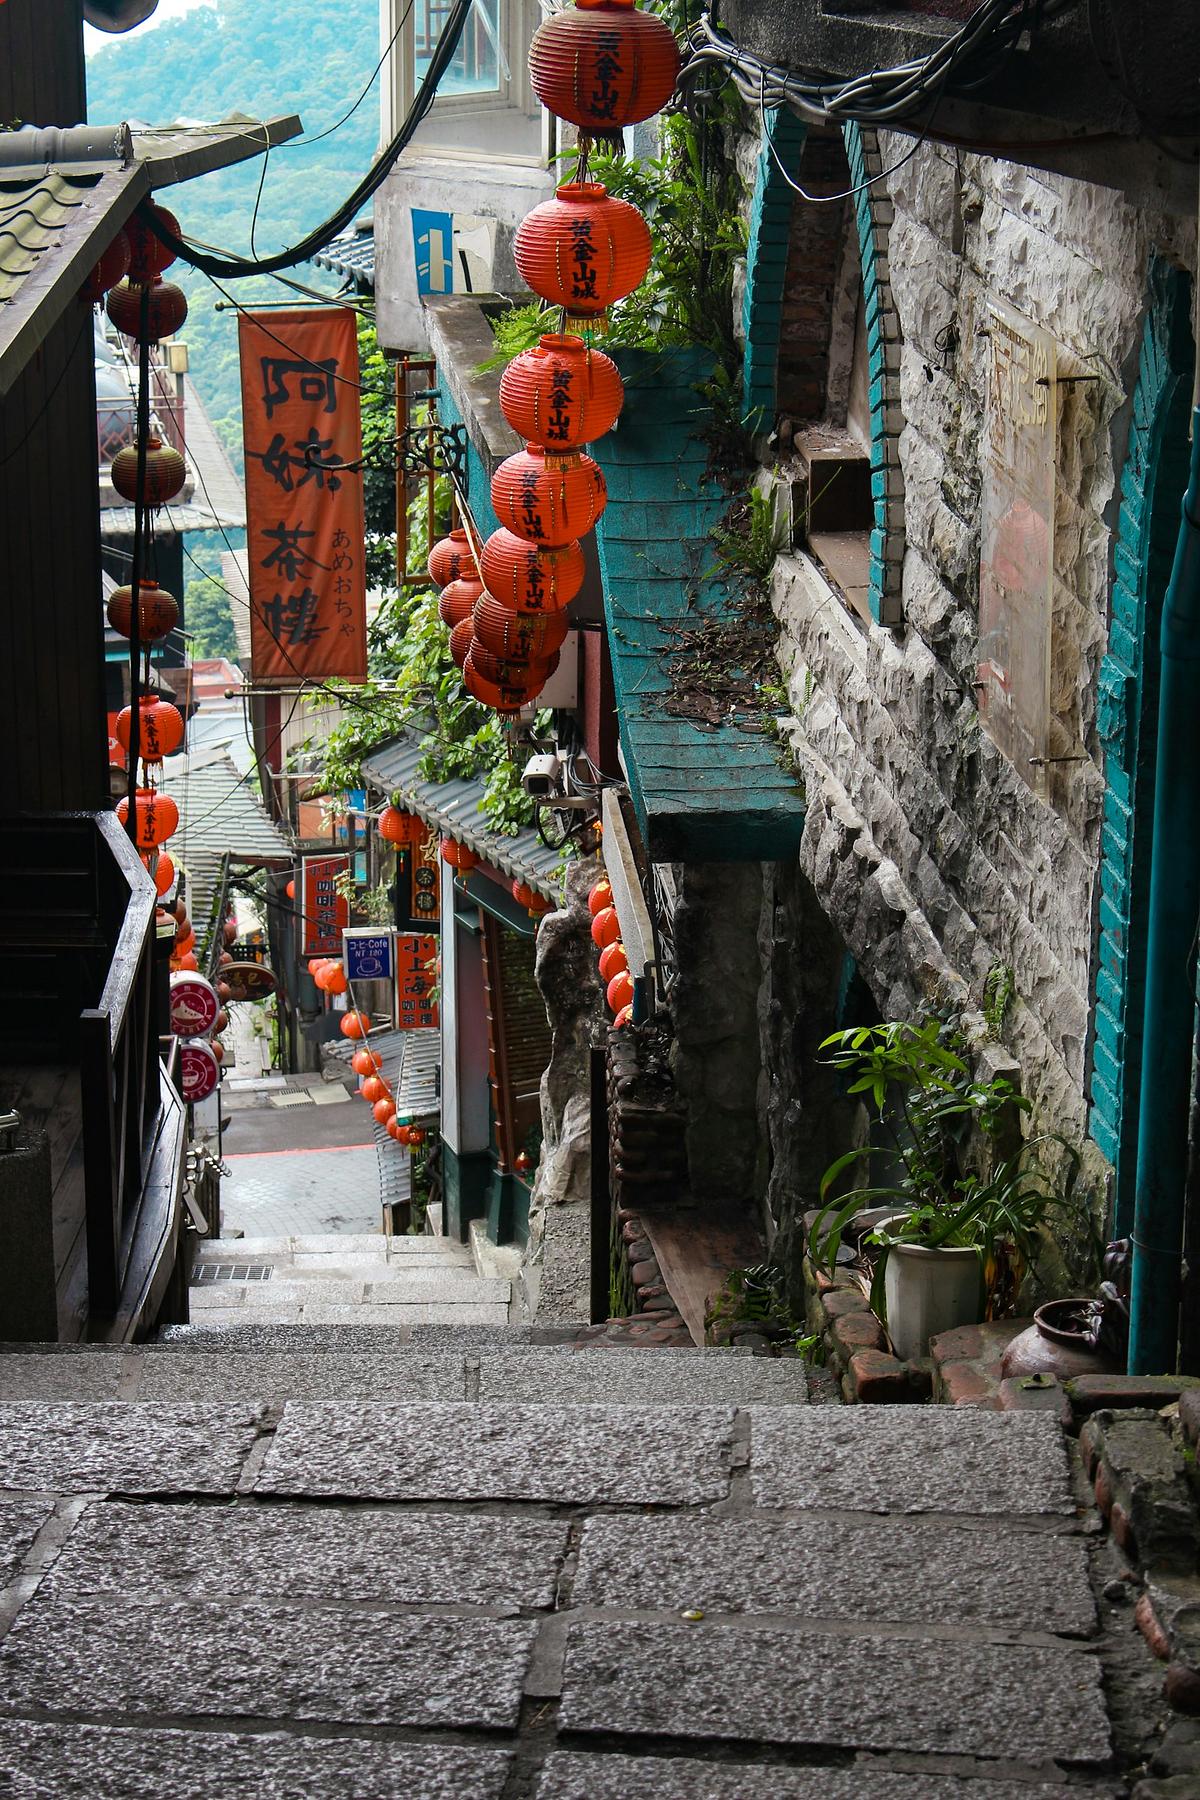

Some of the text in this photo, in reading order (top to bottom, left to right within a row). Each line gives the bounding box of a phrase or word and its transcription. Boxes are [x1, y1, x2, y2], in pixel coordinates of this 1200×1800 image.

[331, 528, 356, 638] あめおちゃ
